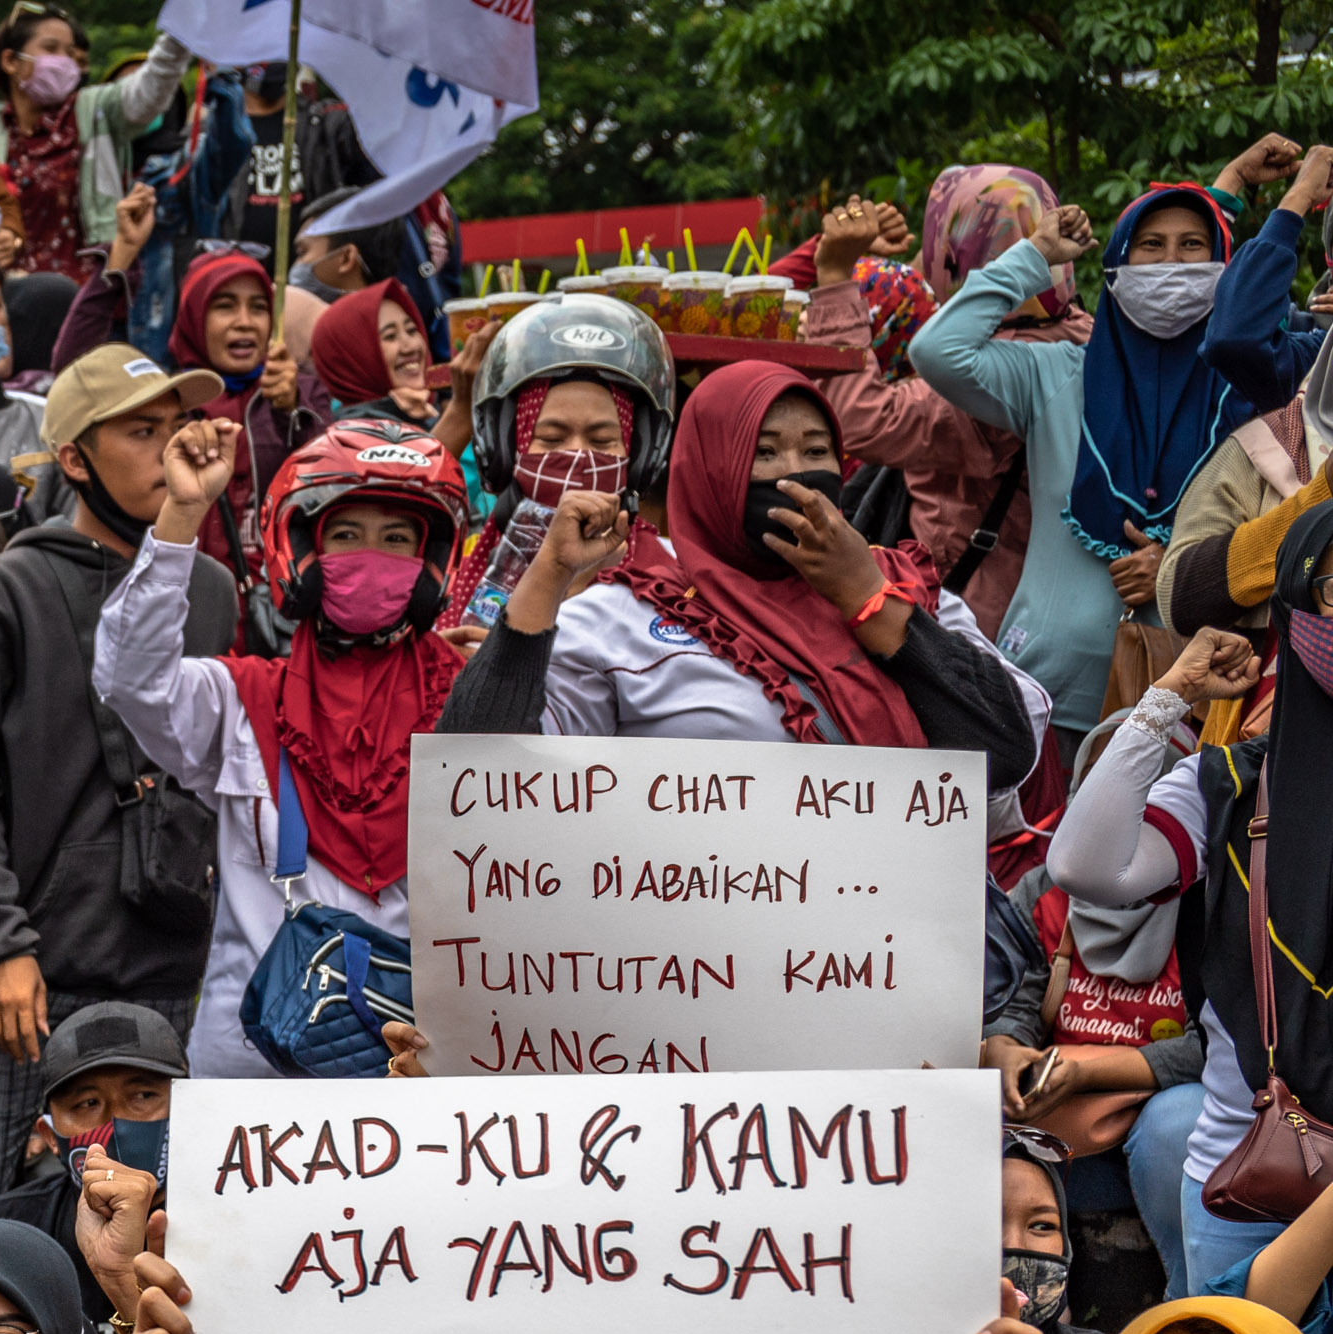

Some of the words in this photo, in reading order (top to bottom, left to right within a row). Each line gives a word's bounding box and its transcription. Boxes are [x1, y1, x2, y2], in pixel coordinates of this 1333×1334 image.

[648, 774, 755, 814] CHAT
[796, 775, 874, 819] AKU
[453, 844, 561, 913] YANG
[432, 937, 734, 999] TUNTUTAN
[579, 1104, 641, 1192] &
[675, 1102, 909, 1196] KAMU
[447, 1220, 638, 1302] YANG
[663, 1220, 855, 1304] SAH
